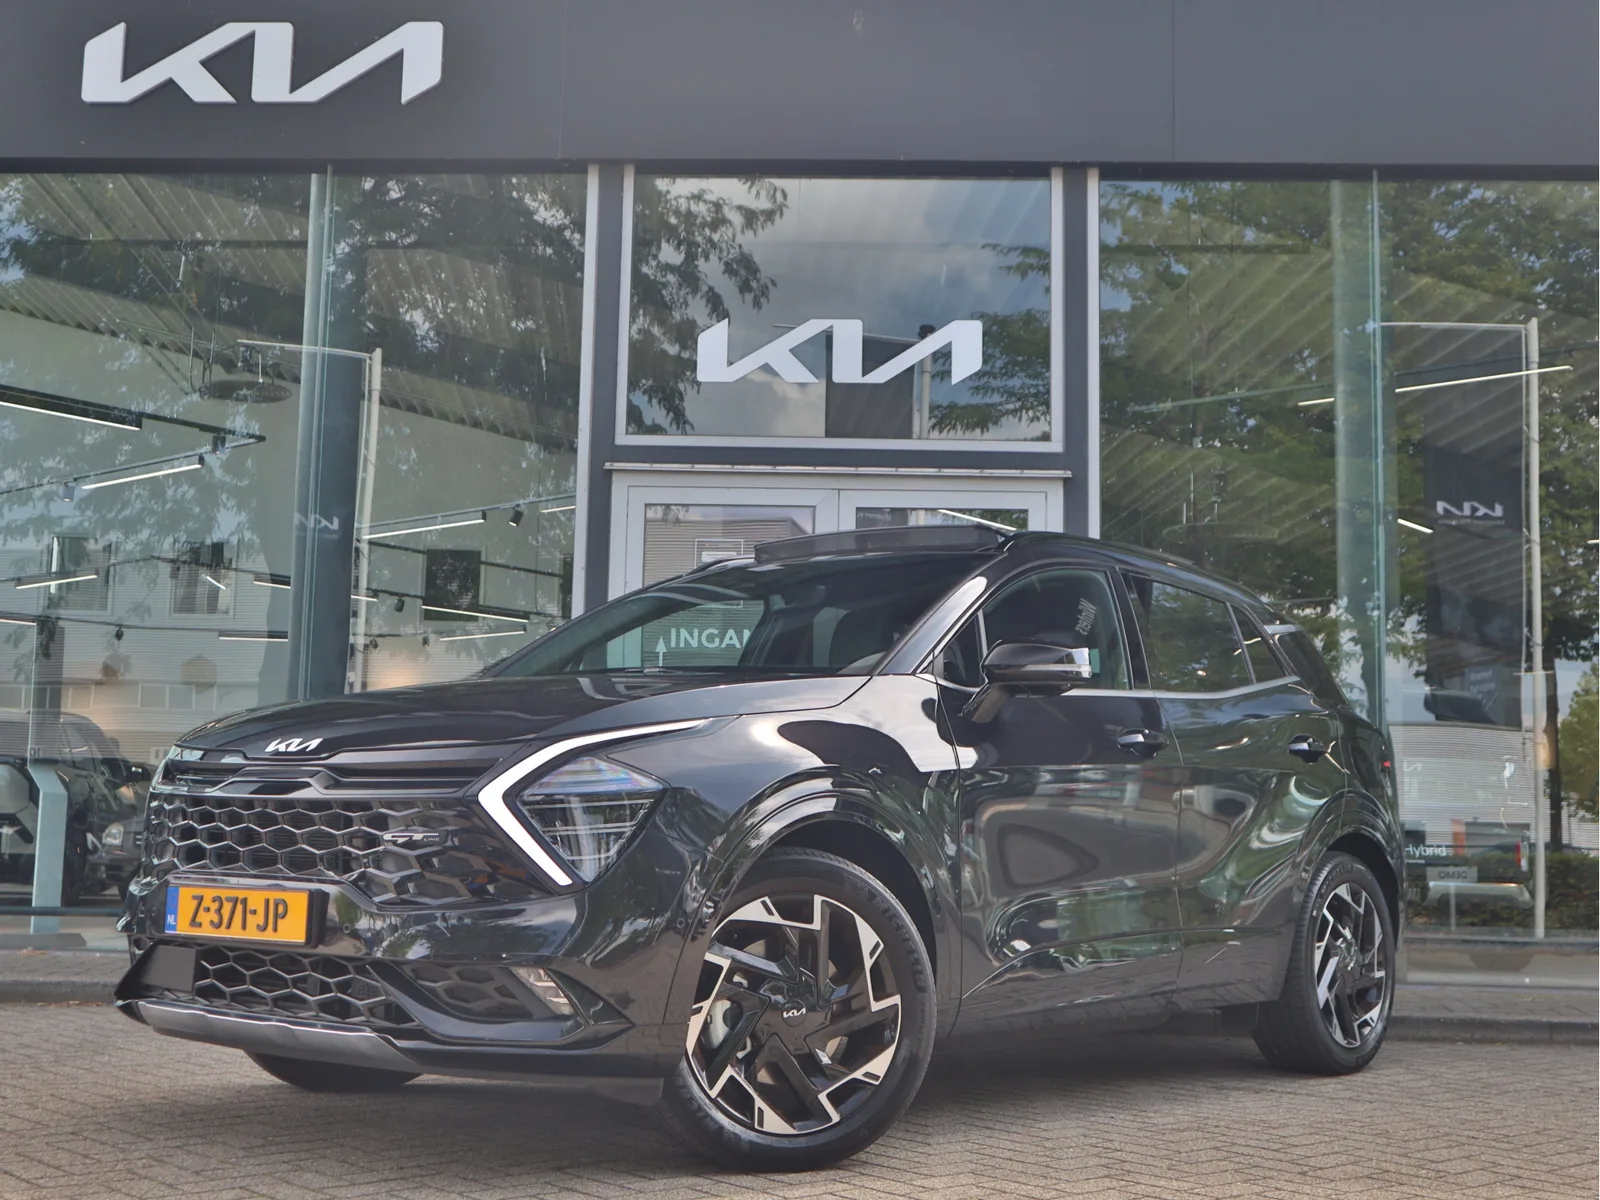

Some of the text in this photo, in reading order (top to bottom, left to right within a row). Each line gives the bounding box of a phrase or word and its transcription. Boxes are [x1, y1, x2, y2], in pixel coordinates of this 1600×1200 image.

[81, 21, 444, 104] KIA
[696, 318, 983, 385] KIA
[264, 738, 324, 752] KIA
[166, 914, 176, 925] NL
[189, 894, 288, 933] Z-371-JP
[783, 1007, 806, 1018] KIA
